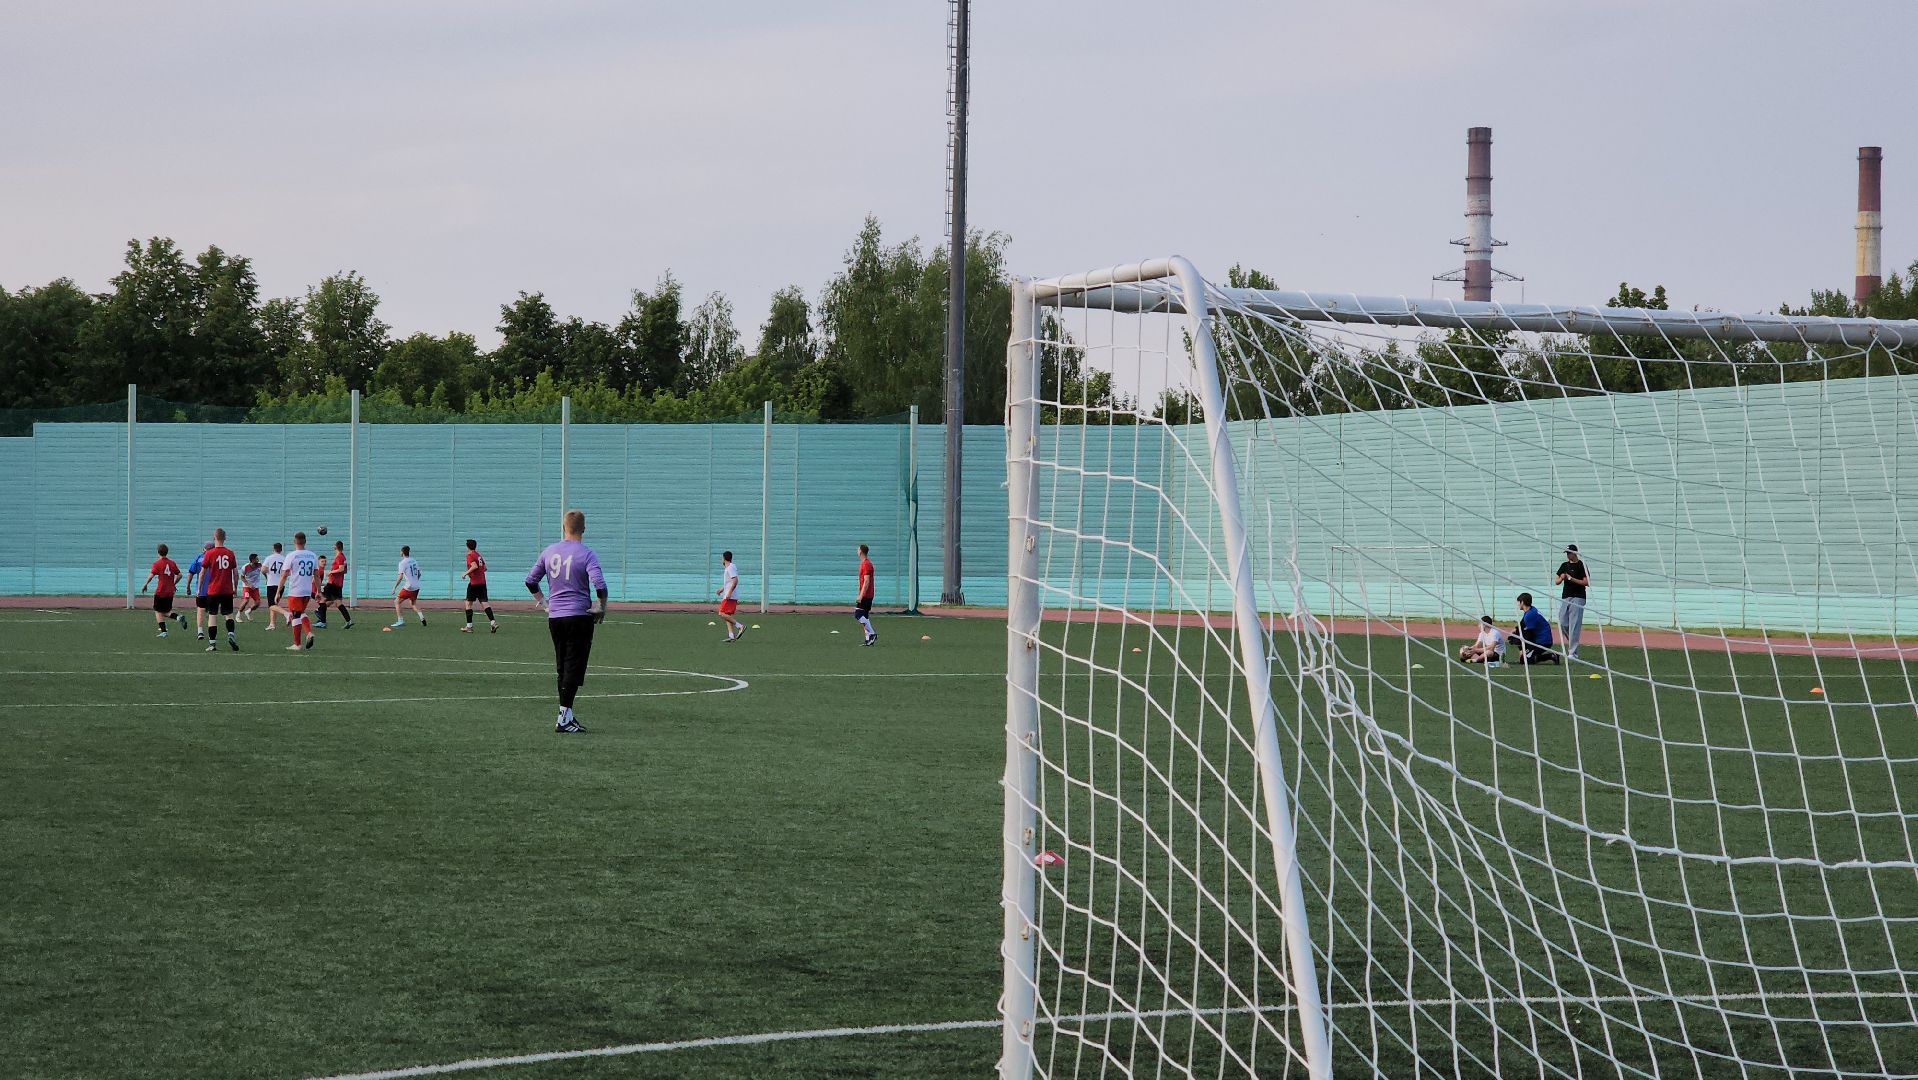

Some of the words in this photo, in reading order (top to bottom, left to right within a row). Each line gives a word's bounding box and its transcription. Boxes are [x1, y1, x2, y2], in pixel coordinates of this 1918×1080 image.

[216, 555, 230, 569] 16
[270, 561, 283, 574] 47
[298, 560, 314, 576] 33
[550, 553, 573, 580] 91
[164, 564, 171, 576] 4
